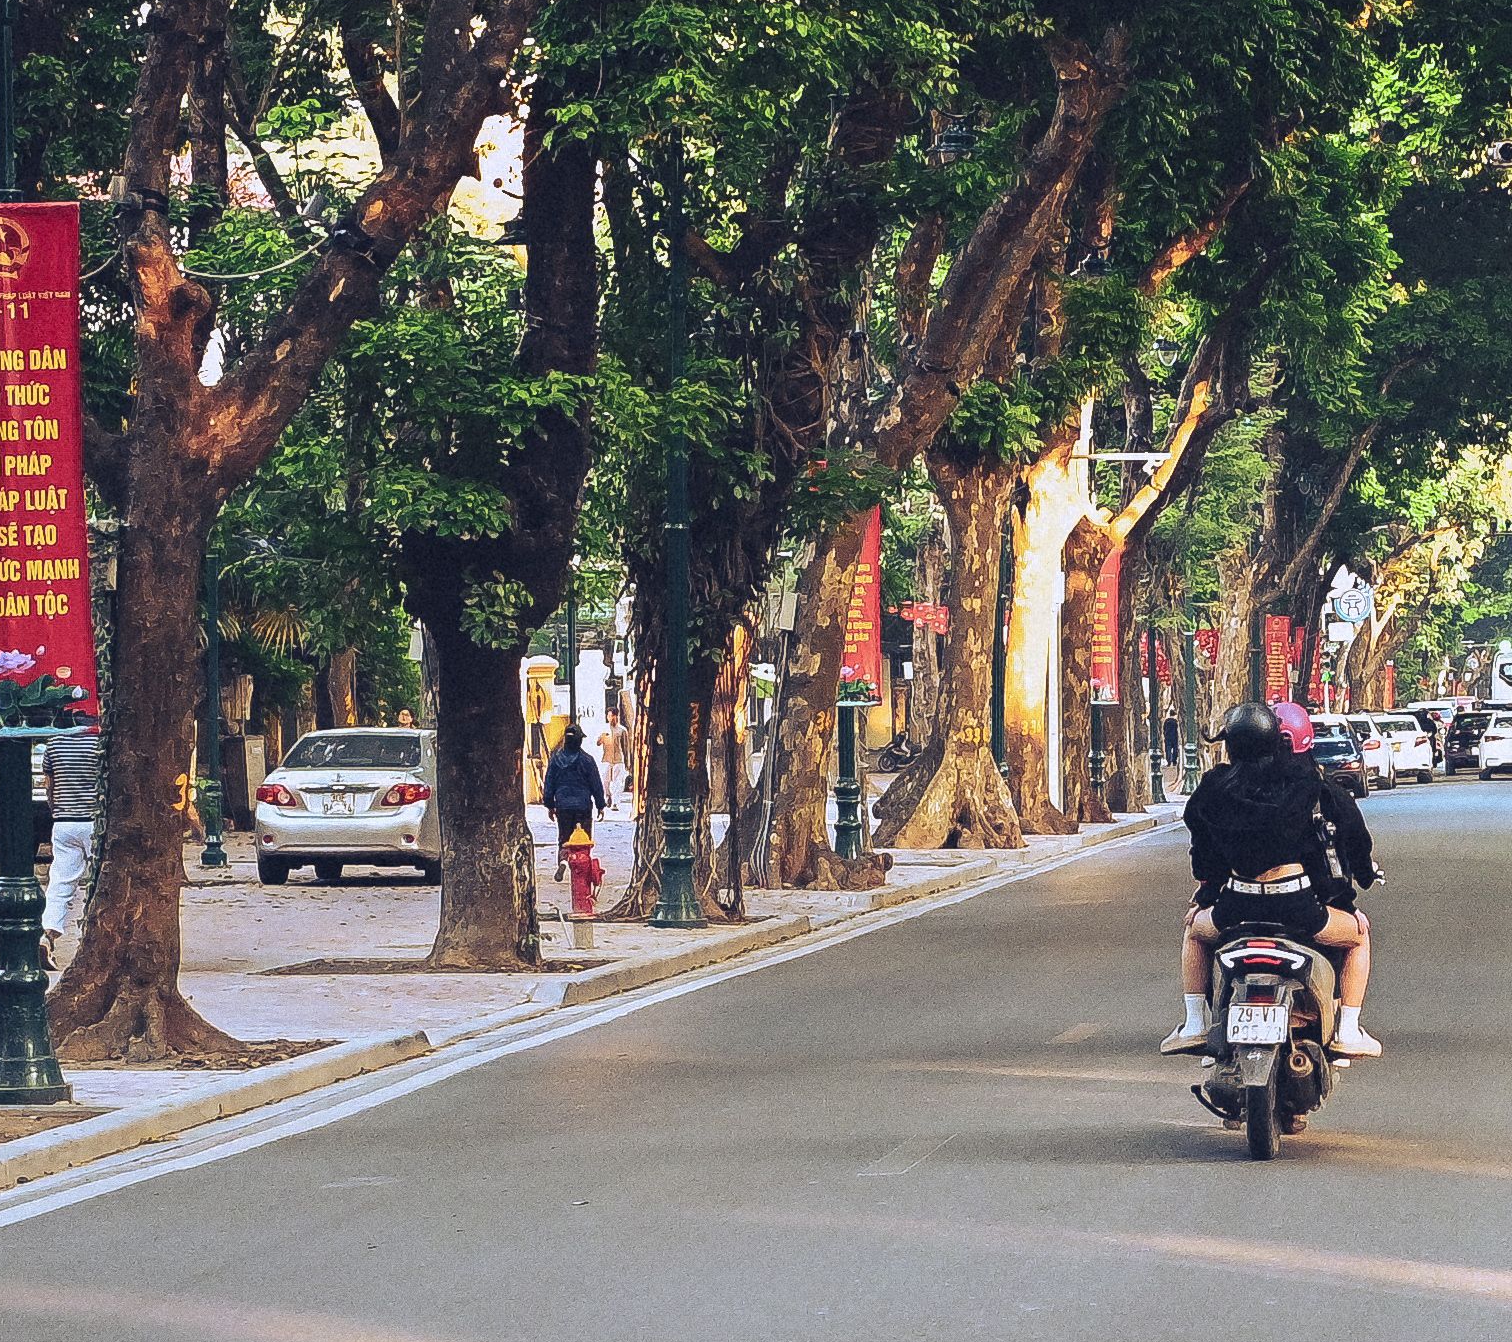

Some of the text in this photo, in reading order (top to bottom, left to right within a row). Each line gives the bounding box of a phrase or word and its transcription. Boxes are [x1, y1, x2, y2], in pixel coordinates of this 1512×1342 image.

[29, 344, 67, 371] DÂN
[4, 380, 50, 407] THỨC
[22, 415, 59, 441] TÔN
[4, 450, 52, 477] PHÁP
[24, 484, 68, 515] LUẬT
[22, 524, 57, 550] TẠO
[25, 558, 80, 586] MẠNH
[33, 589, 69, 620] TỘC
